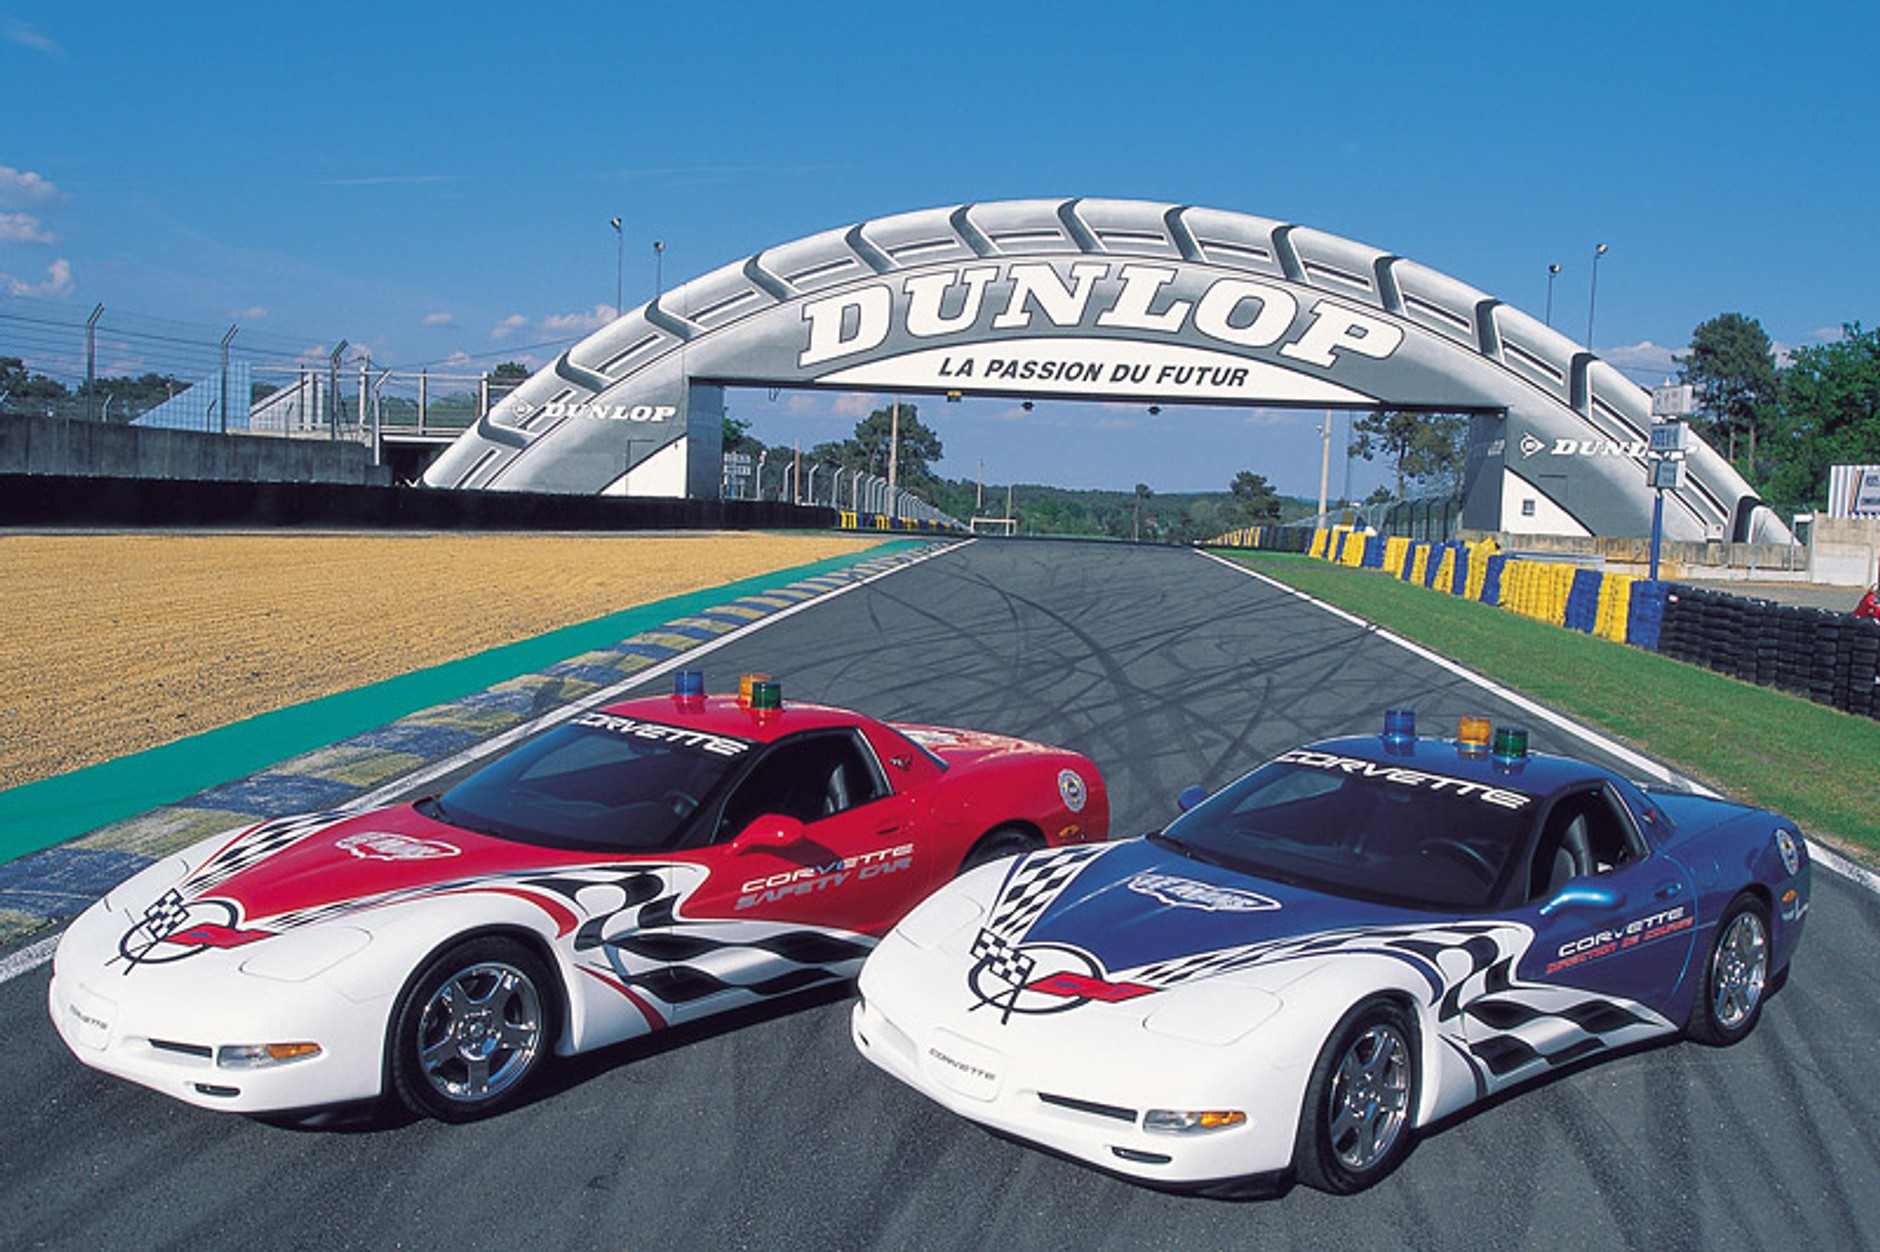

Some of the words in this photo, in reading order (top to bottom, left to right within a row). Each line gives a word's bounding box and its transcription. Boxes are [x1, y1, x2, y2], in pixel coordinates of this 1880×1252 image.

[799, 264, 1404, 369] DUNLOP
[937, 357, 974, 377] LA
[984, 359, 1099, 384] PASSION
[1112, 364, 1149, 385] DU
[1155, 365, 1249, 389] FUTUR
[543, 403, 676, 422] DUNLOP
[1274, 750, 1531, 809] CORVETTE
[734, 871, 850, 911] SAFETY
[858, 857, 912, 881] CAR
[741, 843, 914, 893] CORVETTE
[1558, 906, 1685, 957] CORVETTE
[928, 1047, 996, 1081] CORVETTE
